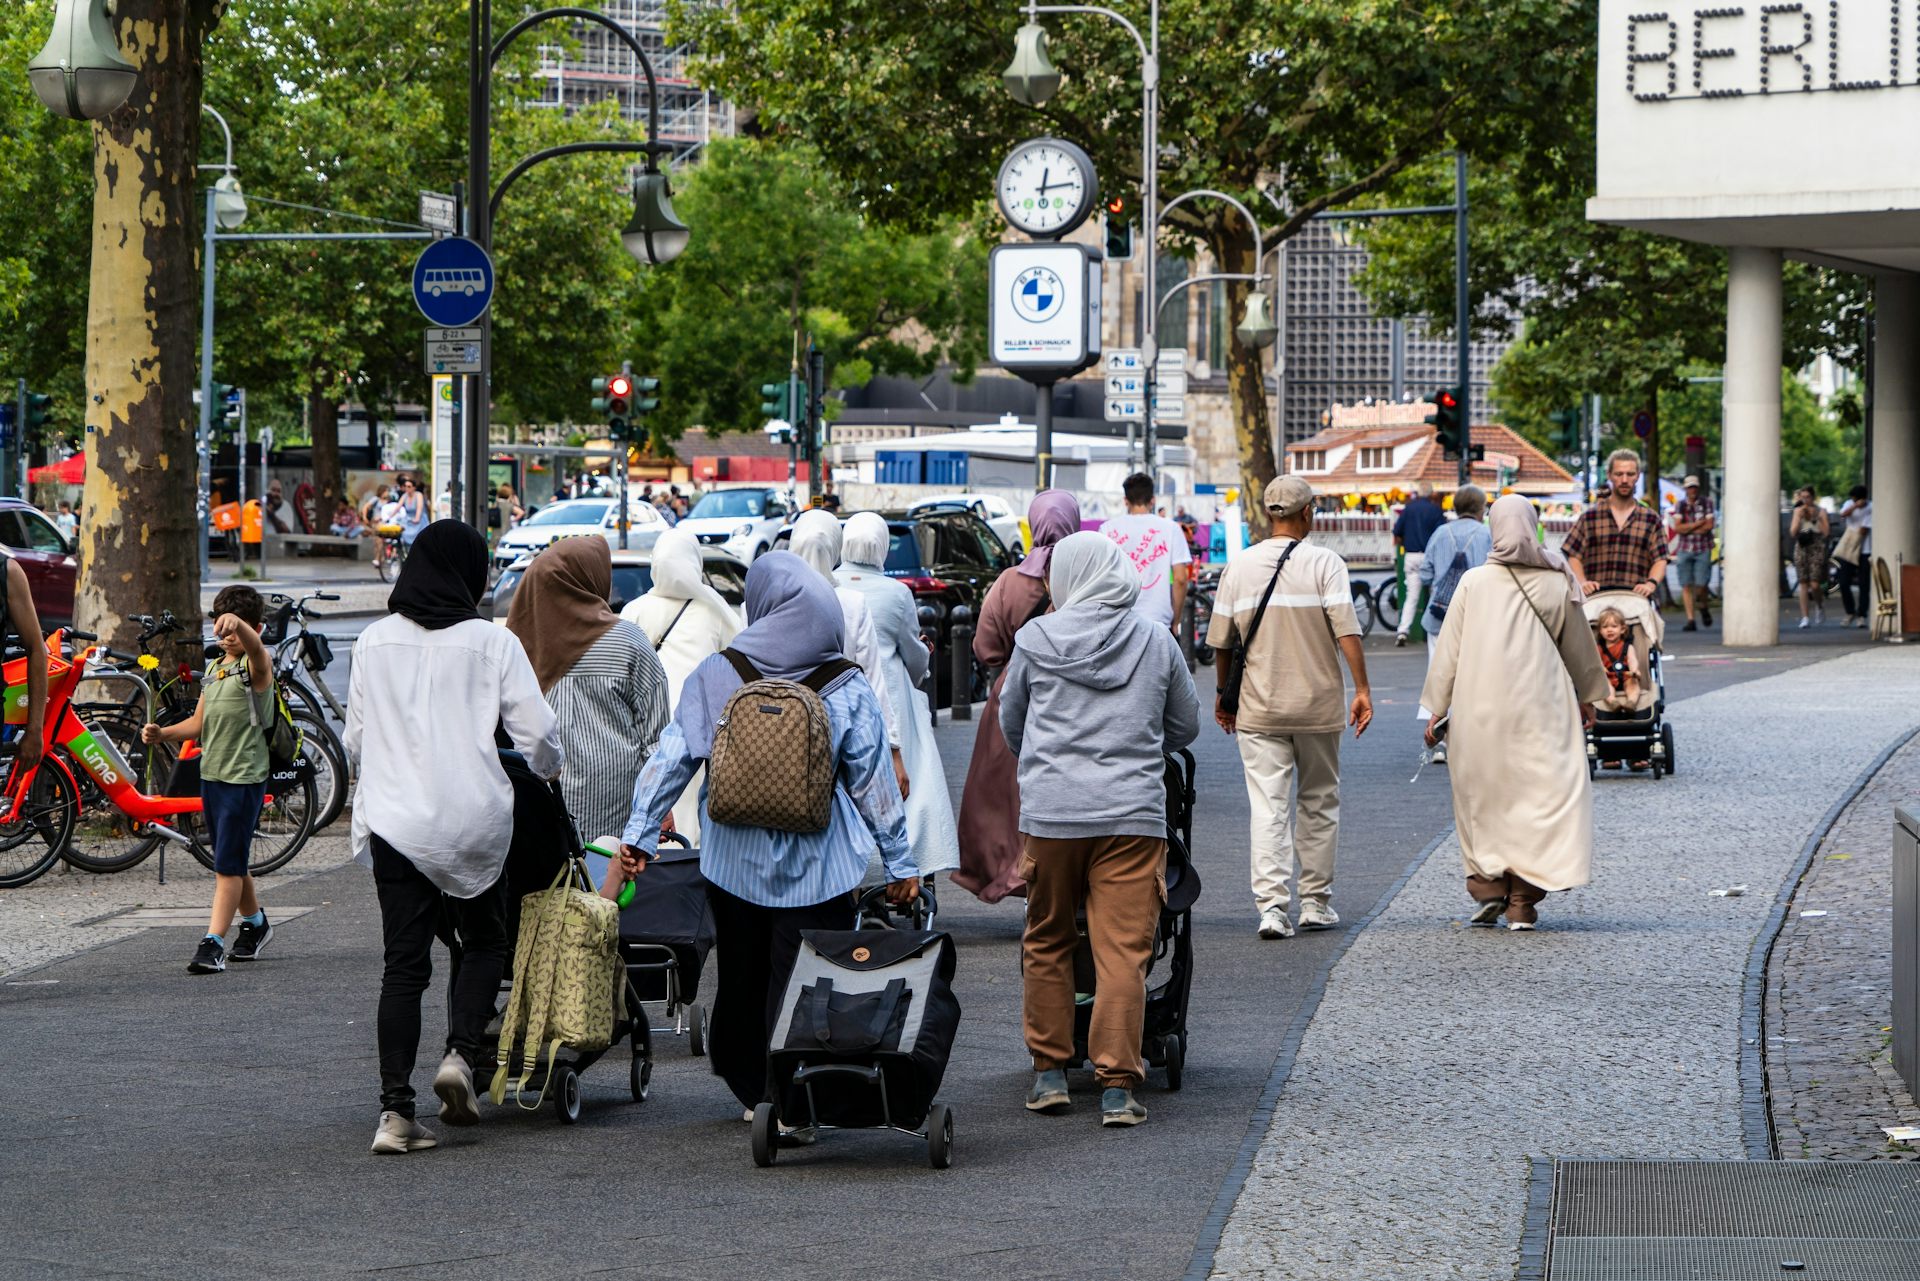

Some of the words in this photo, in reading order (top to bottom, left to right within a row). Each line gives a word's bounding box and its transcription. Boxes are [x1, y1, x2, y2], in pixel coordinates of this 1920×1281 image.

[1627, 0, 1920, 101] BERLI
[1019, 269, 1057, 285] BMW
[82, 743, 118, 785] Lime
